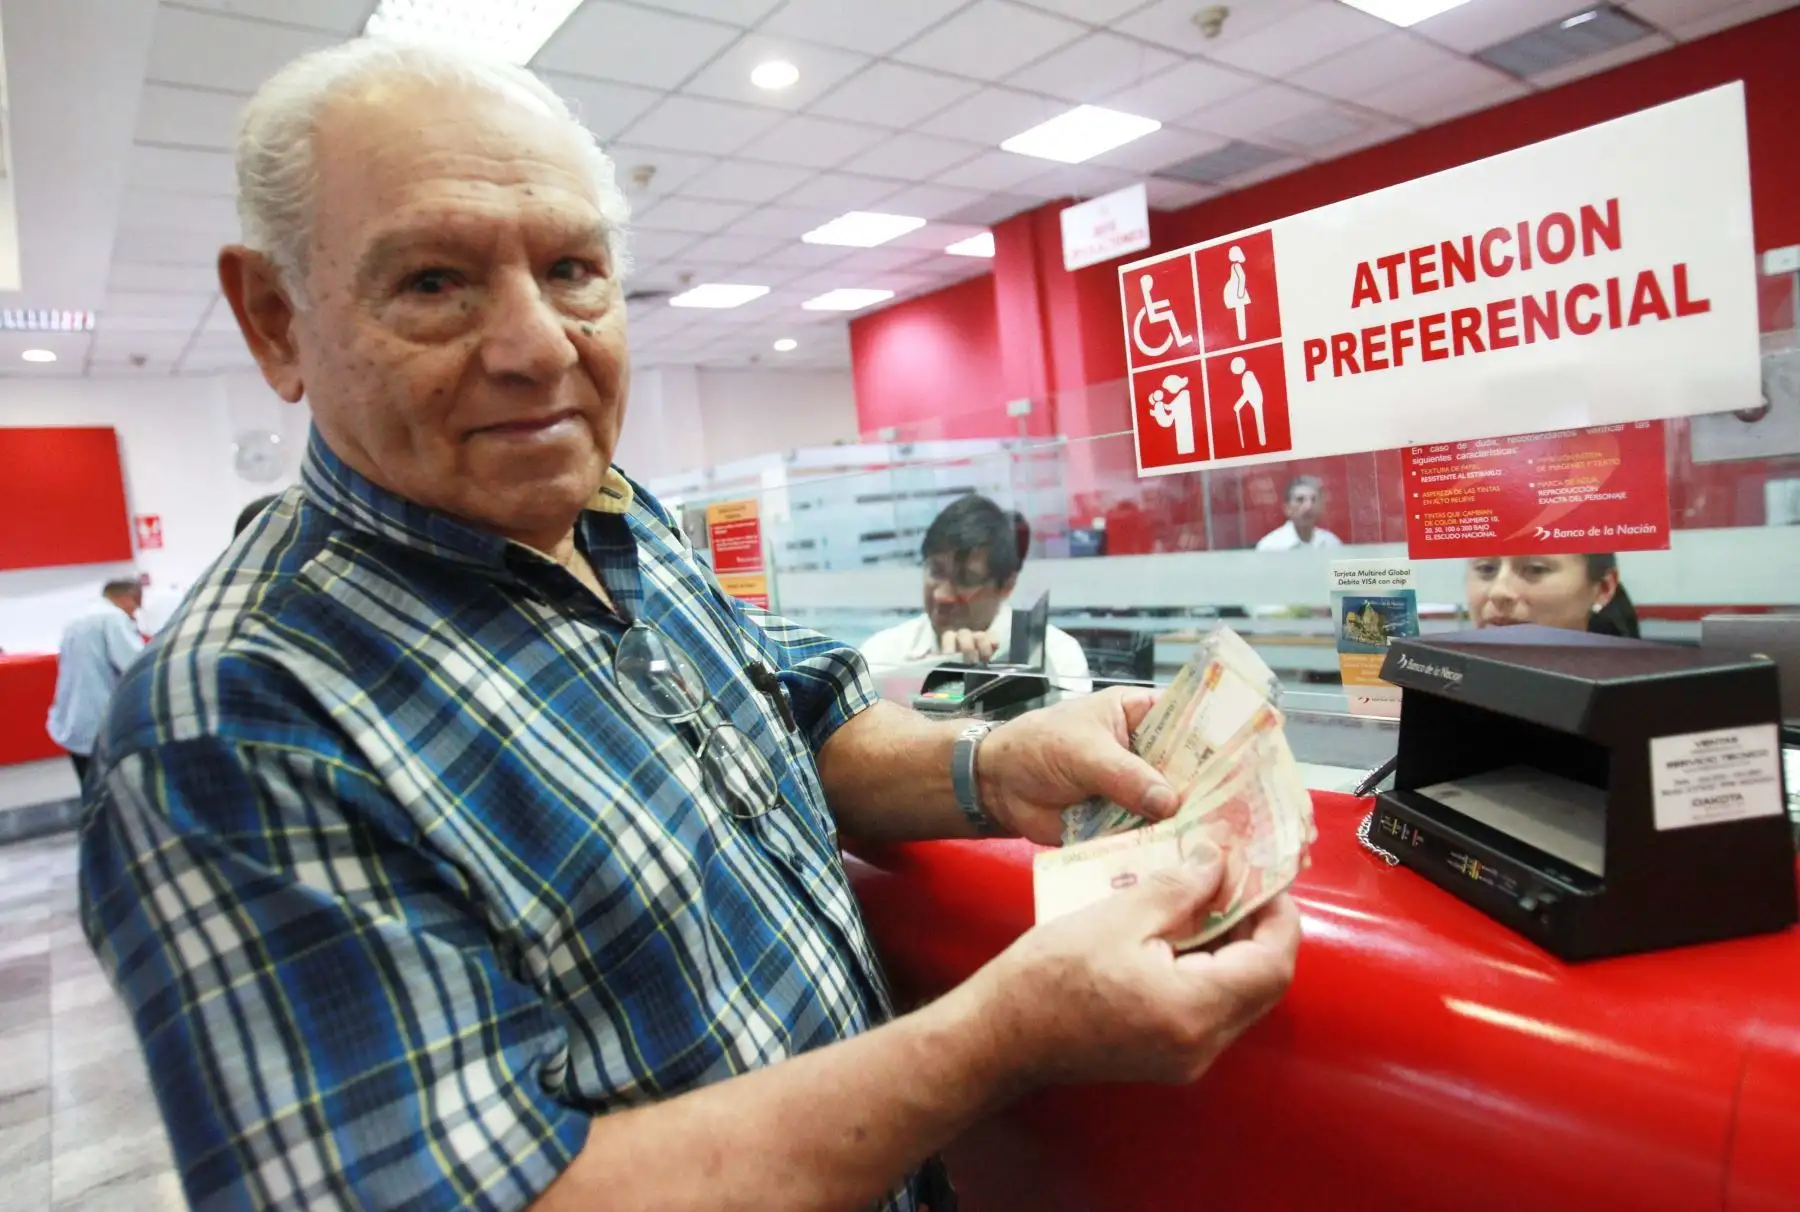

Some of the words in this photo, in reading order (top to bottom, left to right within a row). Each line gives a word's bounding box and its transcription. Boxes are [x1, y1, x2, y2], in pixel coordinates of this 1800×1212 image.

[1351, 197, 1622, 309] ATENCION
[1303, 262, 1711, 382] PREFERENCIAL
[1411, 447, 1423, 455] En
[1429, 445, 1449, 453] caso
[1456, 442, 1468, 450] de
[1412, 455, 1452, 466] siguientes
[1420, 467, 1450, 475] TEXTURA
[1420, 473, 1457, 483] RESISTENTE
[1467, 469, 1502, 479] ESTIRARLO
[1477, 485, 1500, 493] TINTAS
[1433, 497, 1450, 505] ALTO
[1451, 495, 1476, 503] RELIEVE
[1539, 496, 1569, 505] EXACTA
[1570, 495, 1583, 503] DEL
[1462, 509, 1493, 517] CAMBIAN
[1474, 524, 1489, 533] BAJO
[1553, 528, 1585, 539] Banco
[1587, 526, 1601, 537] de
[1604, 526, 1614, 536] la
[1617, 523, 1657, 535] Nación
[1434, 532, 1461, 540] ESCUDO
[1462, 531, 1497, 539] NACIONAL
[1333, 570, 1356, 578] Tarjeta
[1357, 569, 1387, 577] Multired
[1388, 569, 1411, 577] Global
[1391, 578, 1407, 588] chip
[1666, 757, 1717, 768] SERVICIO
